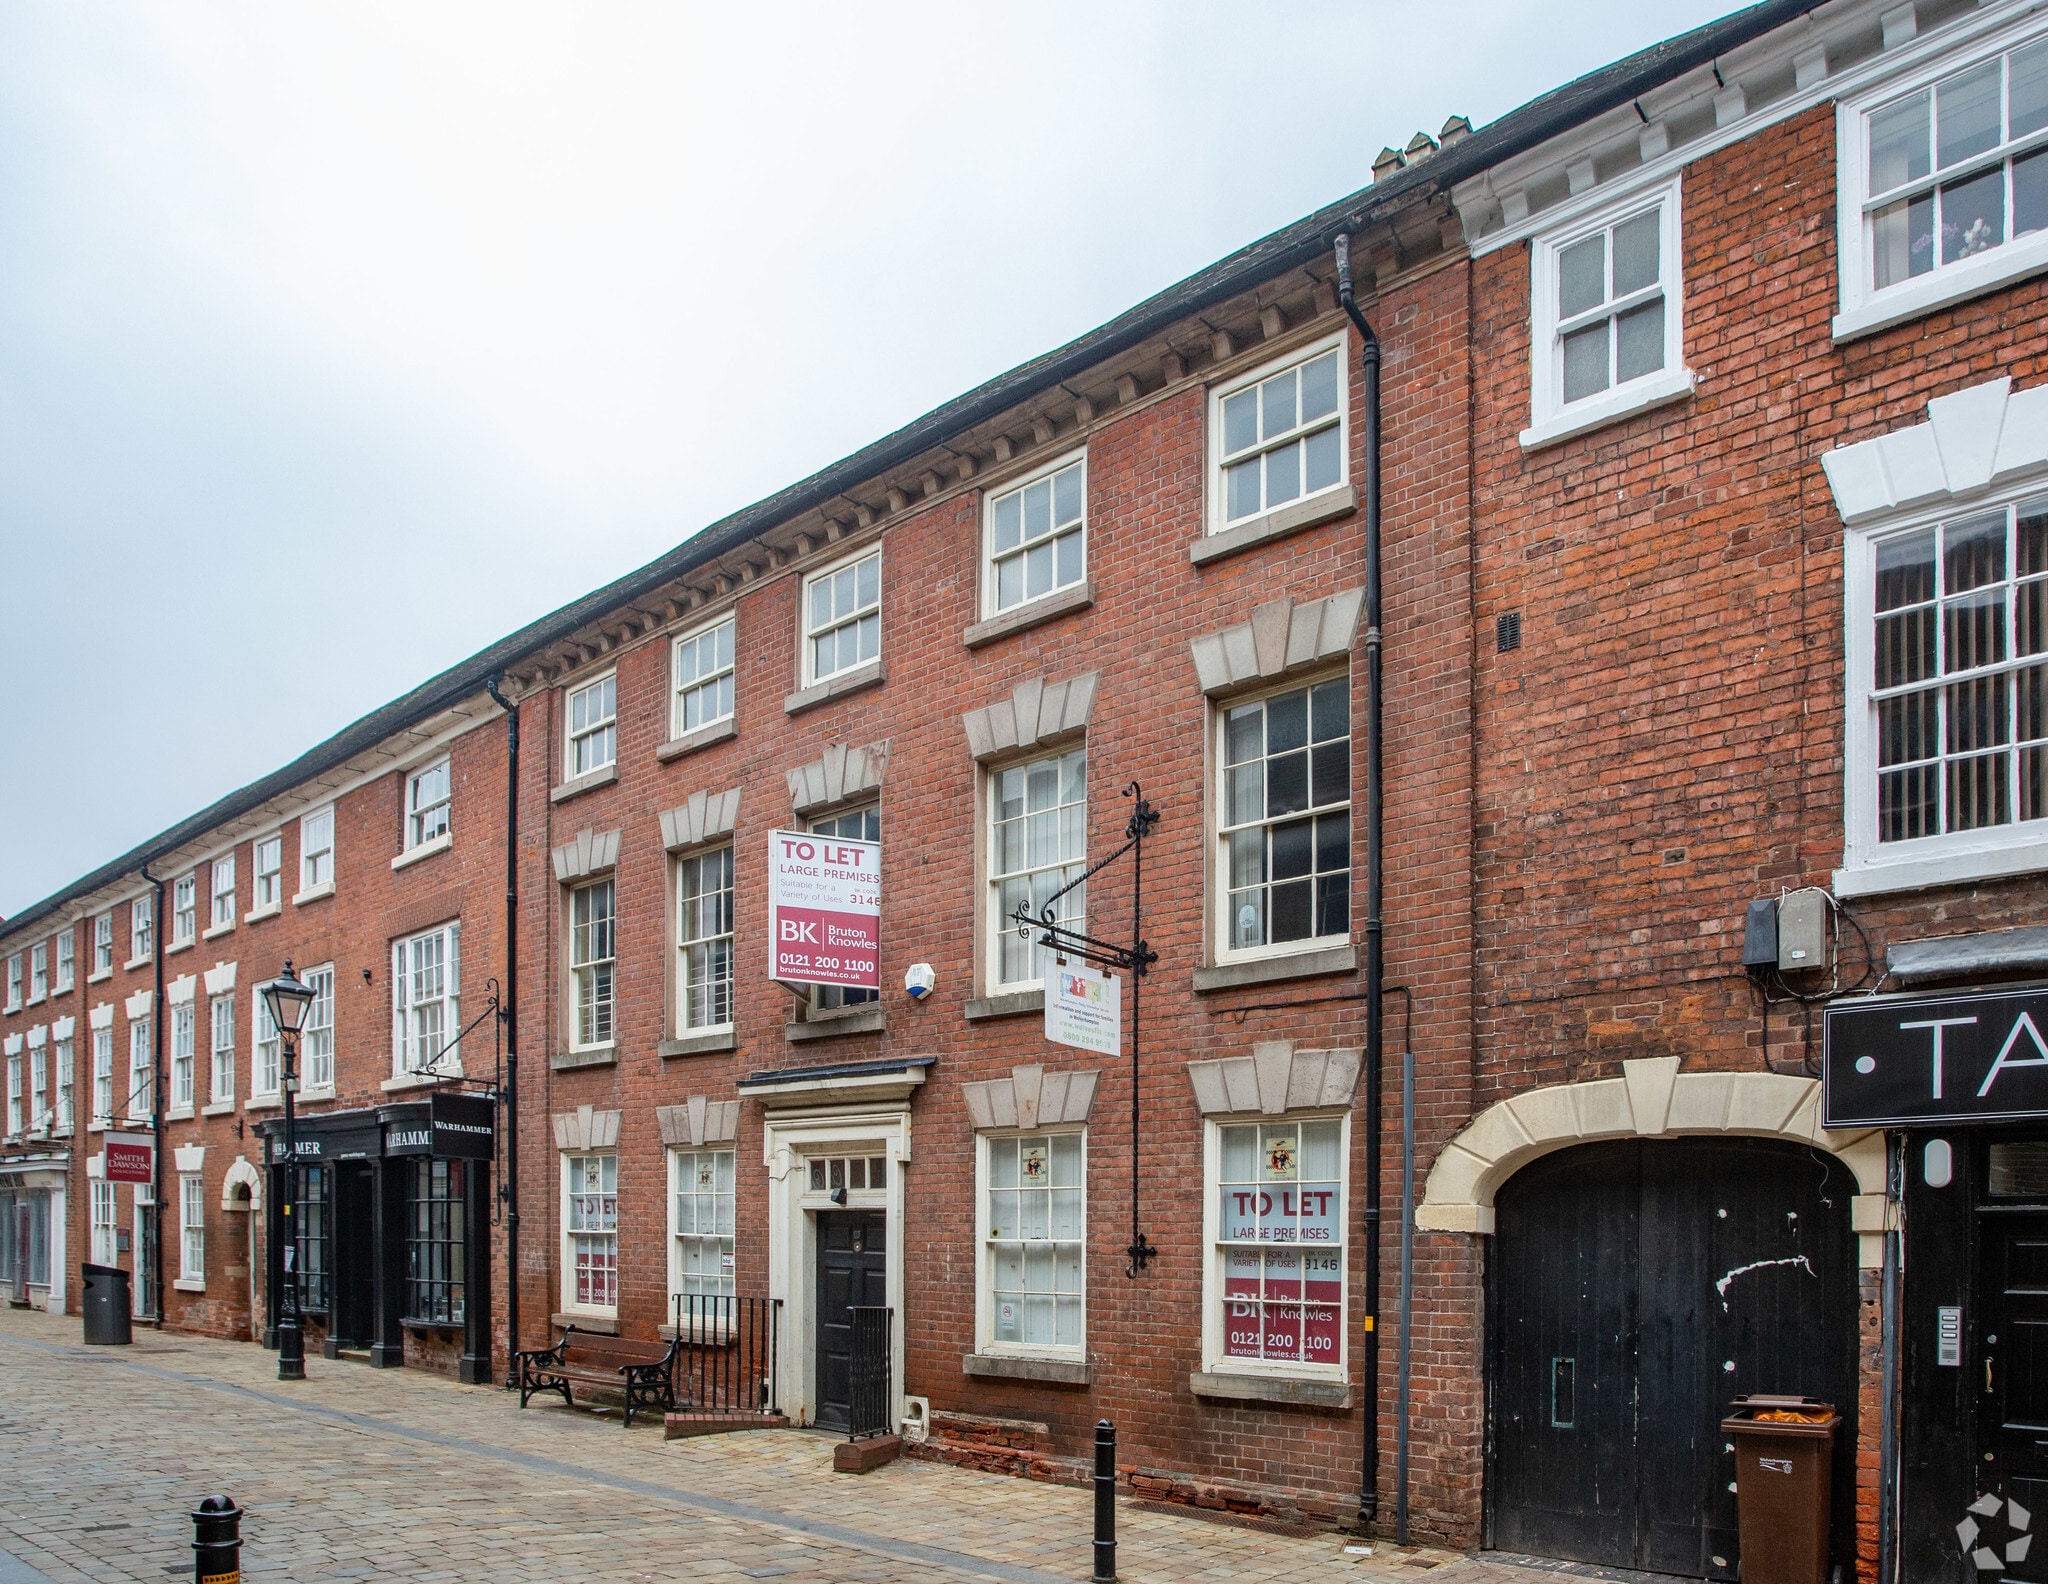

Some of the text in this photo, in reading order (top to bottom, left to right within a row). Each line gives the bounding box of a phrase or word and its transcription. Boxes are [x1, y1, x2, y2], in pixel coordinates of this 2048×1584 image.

[780, 840, 865, 867] TO LET
[780, 864, 880, 884] LARGE PREMISES
[780, 879, 813, 890] Suitable
[816, 882, 827, 891] for
[780, 889, 843, 904] Variety of Uses
[849, 894, 880, 906] 3146
[780, 919, 820, 945] BK
[828, 924, 867, 938] Bruton
[828, 935, 878, 950] Knowles
[780, 952, 874, 972] 0121 200 1100
[779, 966, 860, 979] brutonknowles.co.uk
[434, 1120, 492, 1134] WARHAMMER
[386, 1130, 432, 1148] WARHAMM
[113, 1152, 145, 1162] SMITH
[108, 1160, 150, 1170] DAWSON
[1233, 1192, 1333, 1216] TO LET
[1233, 1227, 1330, 1239] LARGE PREMISES
[1233, 1250, 1291, 1259] SUITABL FOR A
[1265, 1260, 1275, 1268] OF
[1277, 1260, 1296, 1268] USES
[1306, 1259, 1338, 1271] 3146
[1232, 1292, 1271, 1319] BK
[1231, 1331, 1332, 1350] 0121 200 100
